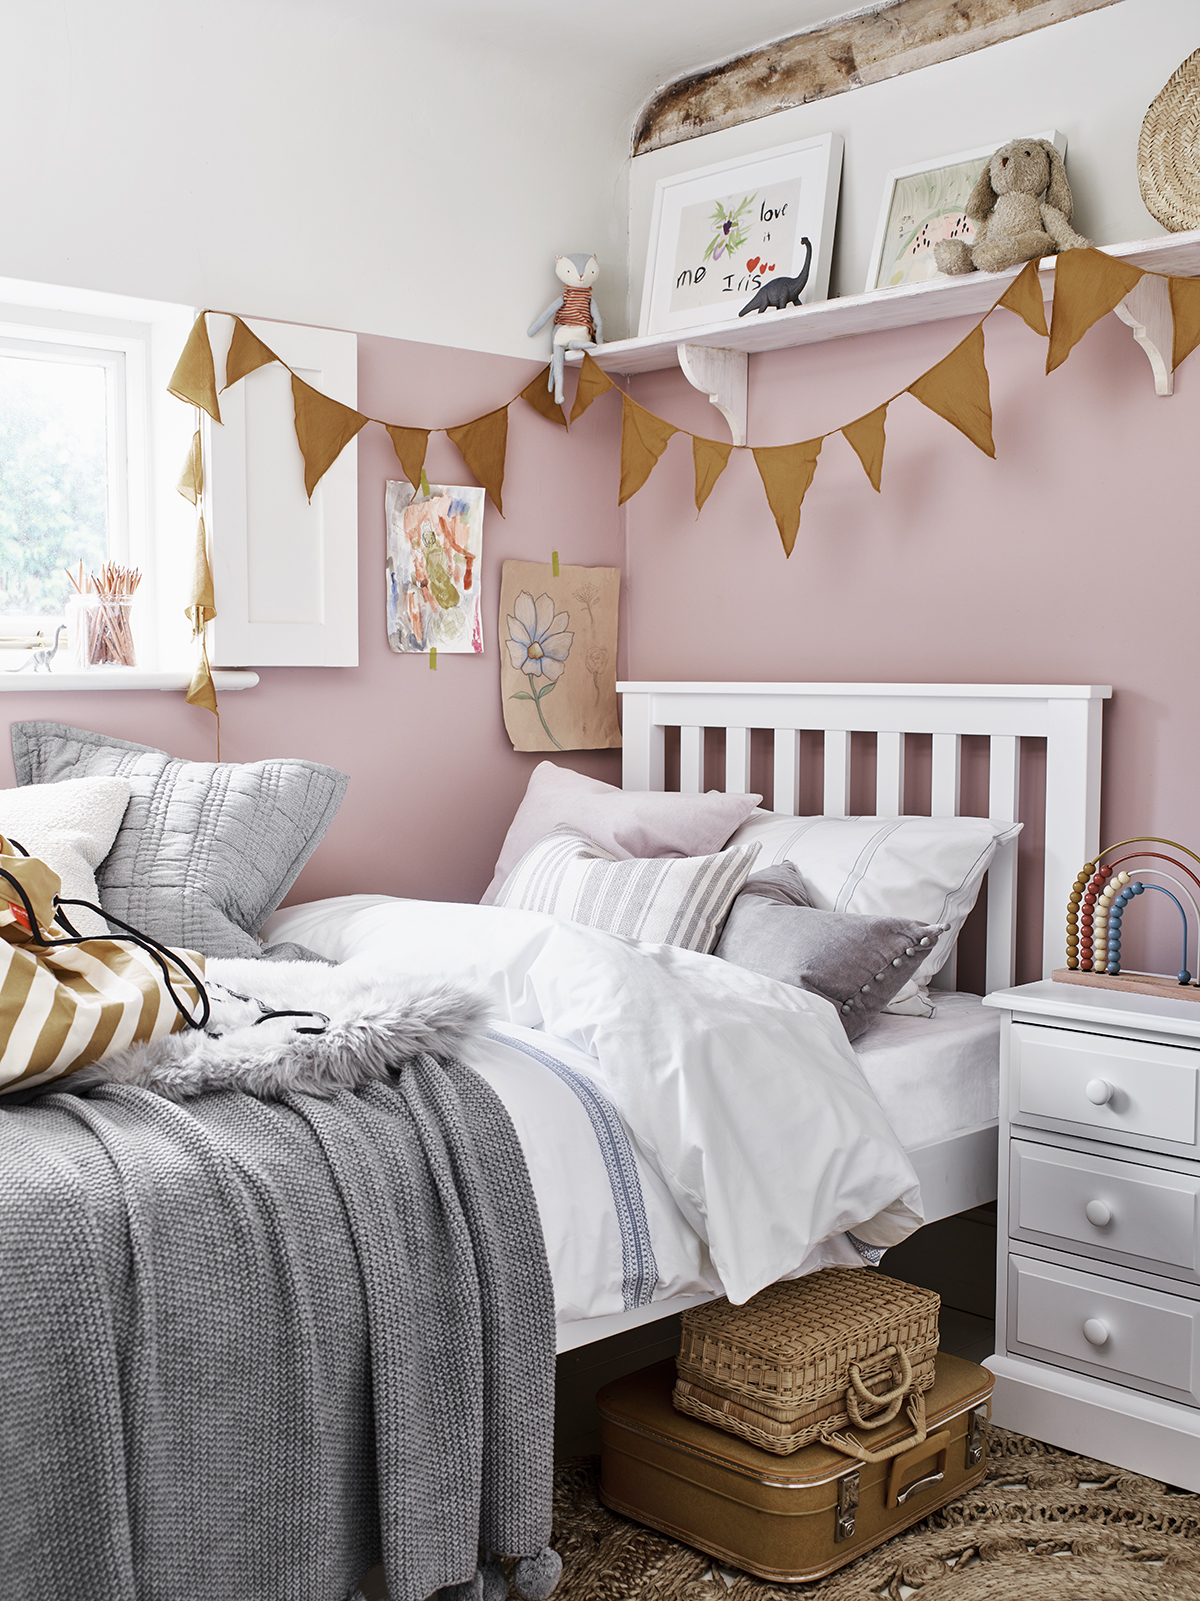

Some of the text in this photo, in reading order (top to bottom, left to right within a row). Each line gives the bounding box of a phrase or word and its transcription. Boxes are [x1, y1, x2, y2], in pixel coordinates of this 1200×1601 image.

[760, 199, 788, 221] love
[676, 266, 706, 289] me
[722, 274, 762, 292] Iris
